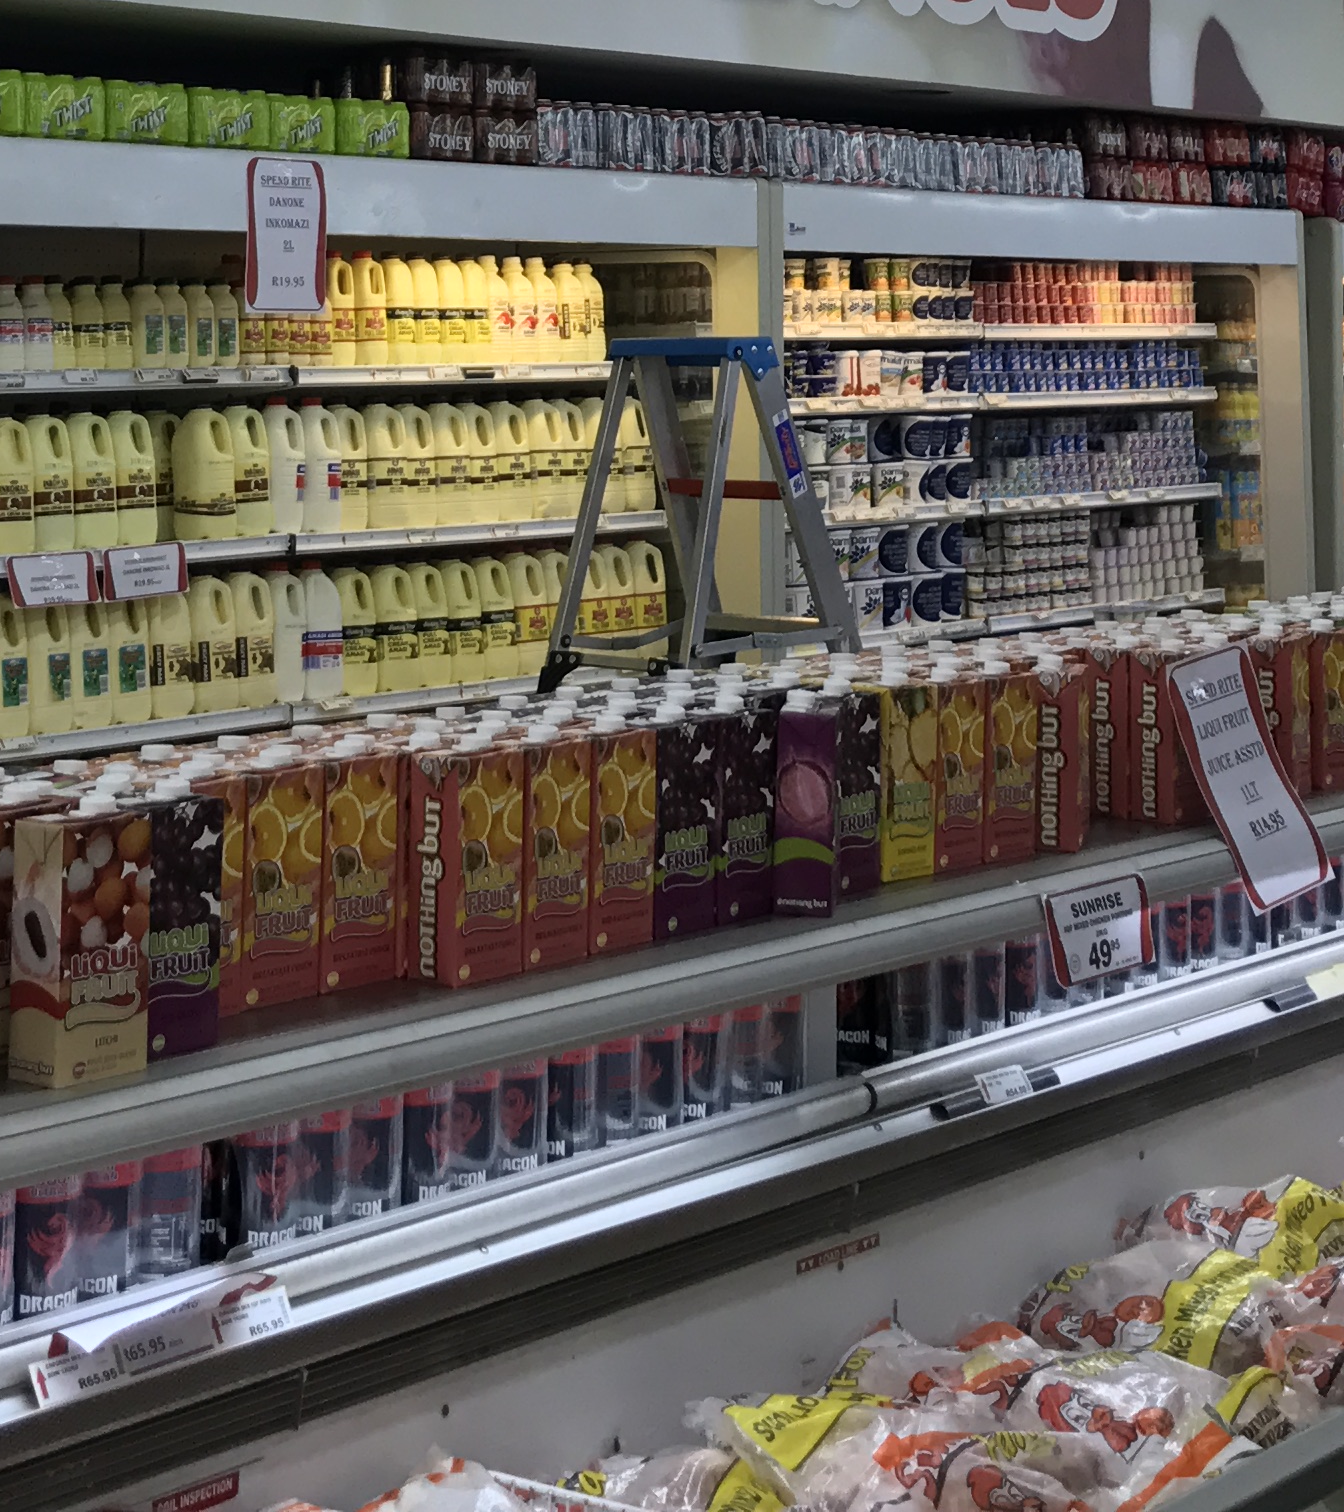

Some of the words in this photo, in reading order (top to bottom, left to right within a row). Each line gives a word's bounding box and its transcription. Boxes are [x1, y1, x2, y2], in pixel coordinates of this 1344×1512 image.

[423, 71, 470, 93] STONEY
[486, 77, 530, 97] STONEY
[427, 131, 472, 152] STONEY
[488, 131, 533, 151] STONEY
[291, 176, 312, 187] RITE
[269, 196, 305, 208] DANONE
[265, 218, 310, 229] INKOMAZI
[271, 276, 305, 287] R19.95
[1218, 672, 1242, 694] RITE
[1196, 718, 1223, 741] LIQUI
[1222, 706, 1251, 733] FRUIT
[1206, 751, 1235, 777] JUICE
[1234, 740, 1265, 766] ASSTD
[1249, 809, 1287, 838] R14.95
[1070, 891, 1124, 919] SUNRISE
[1088, 938, 1112, 970] 49
[249, 1317, 285, 1337] R65.95
[180, 1477, 233, 1508] INSPECTION
